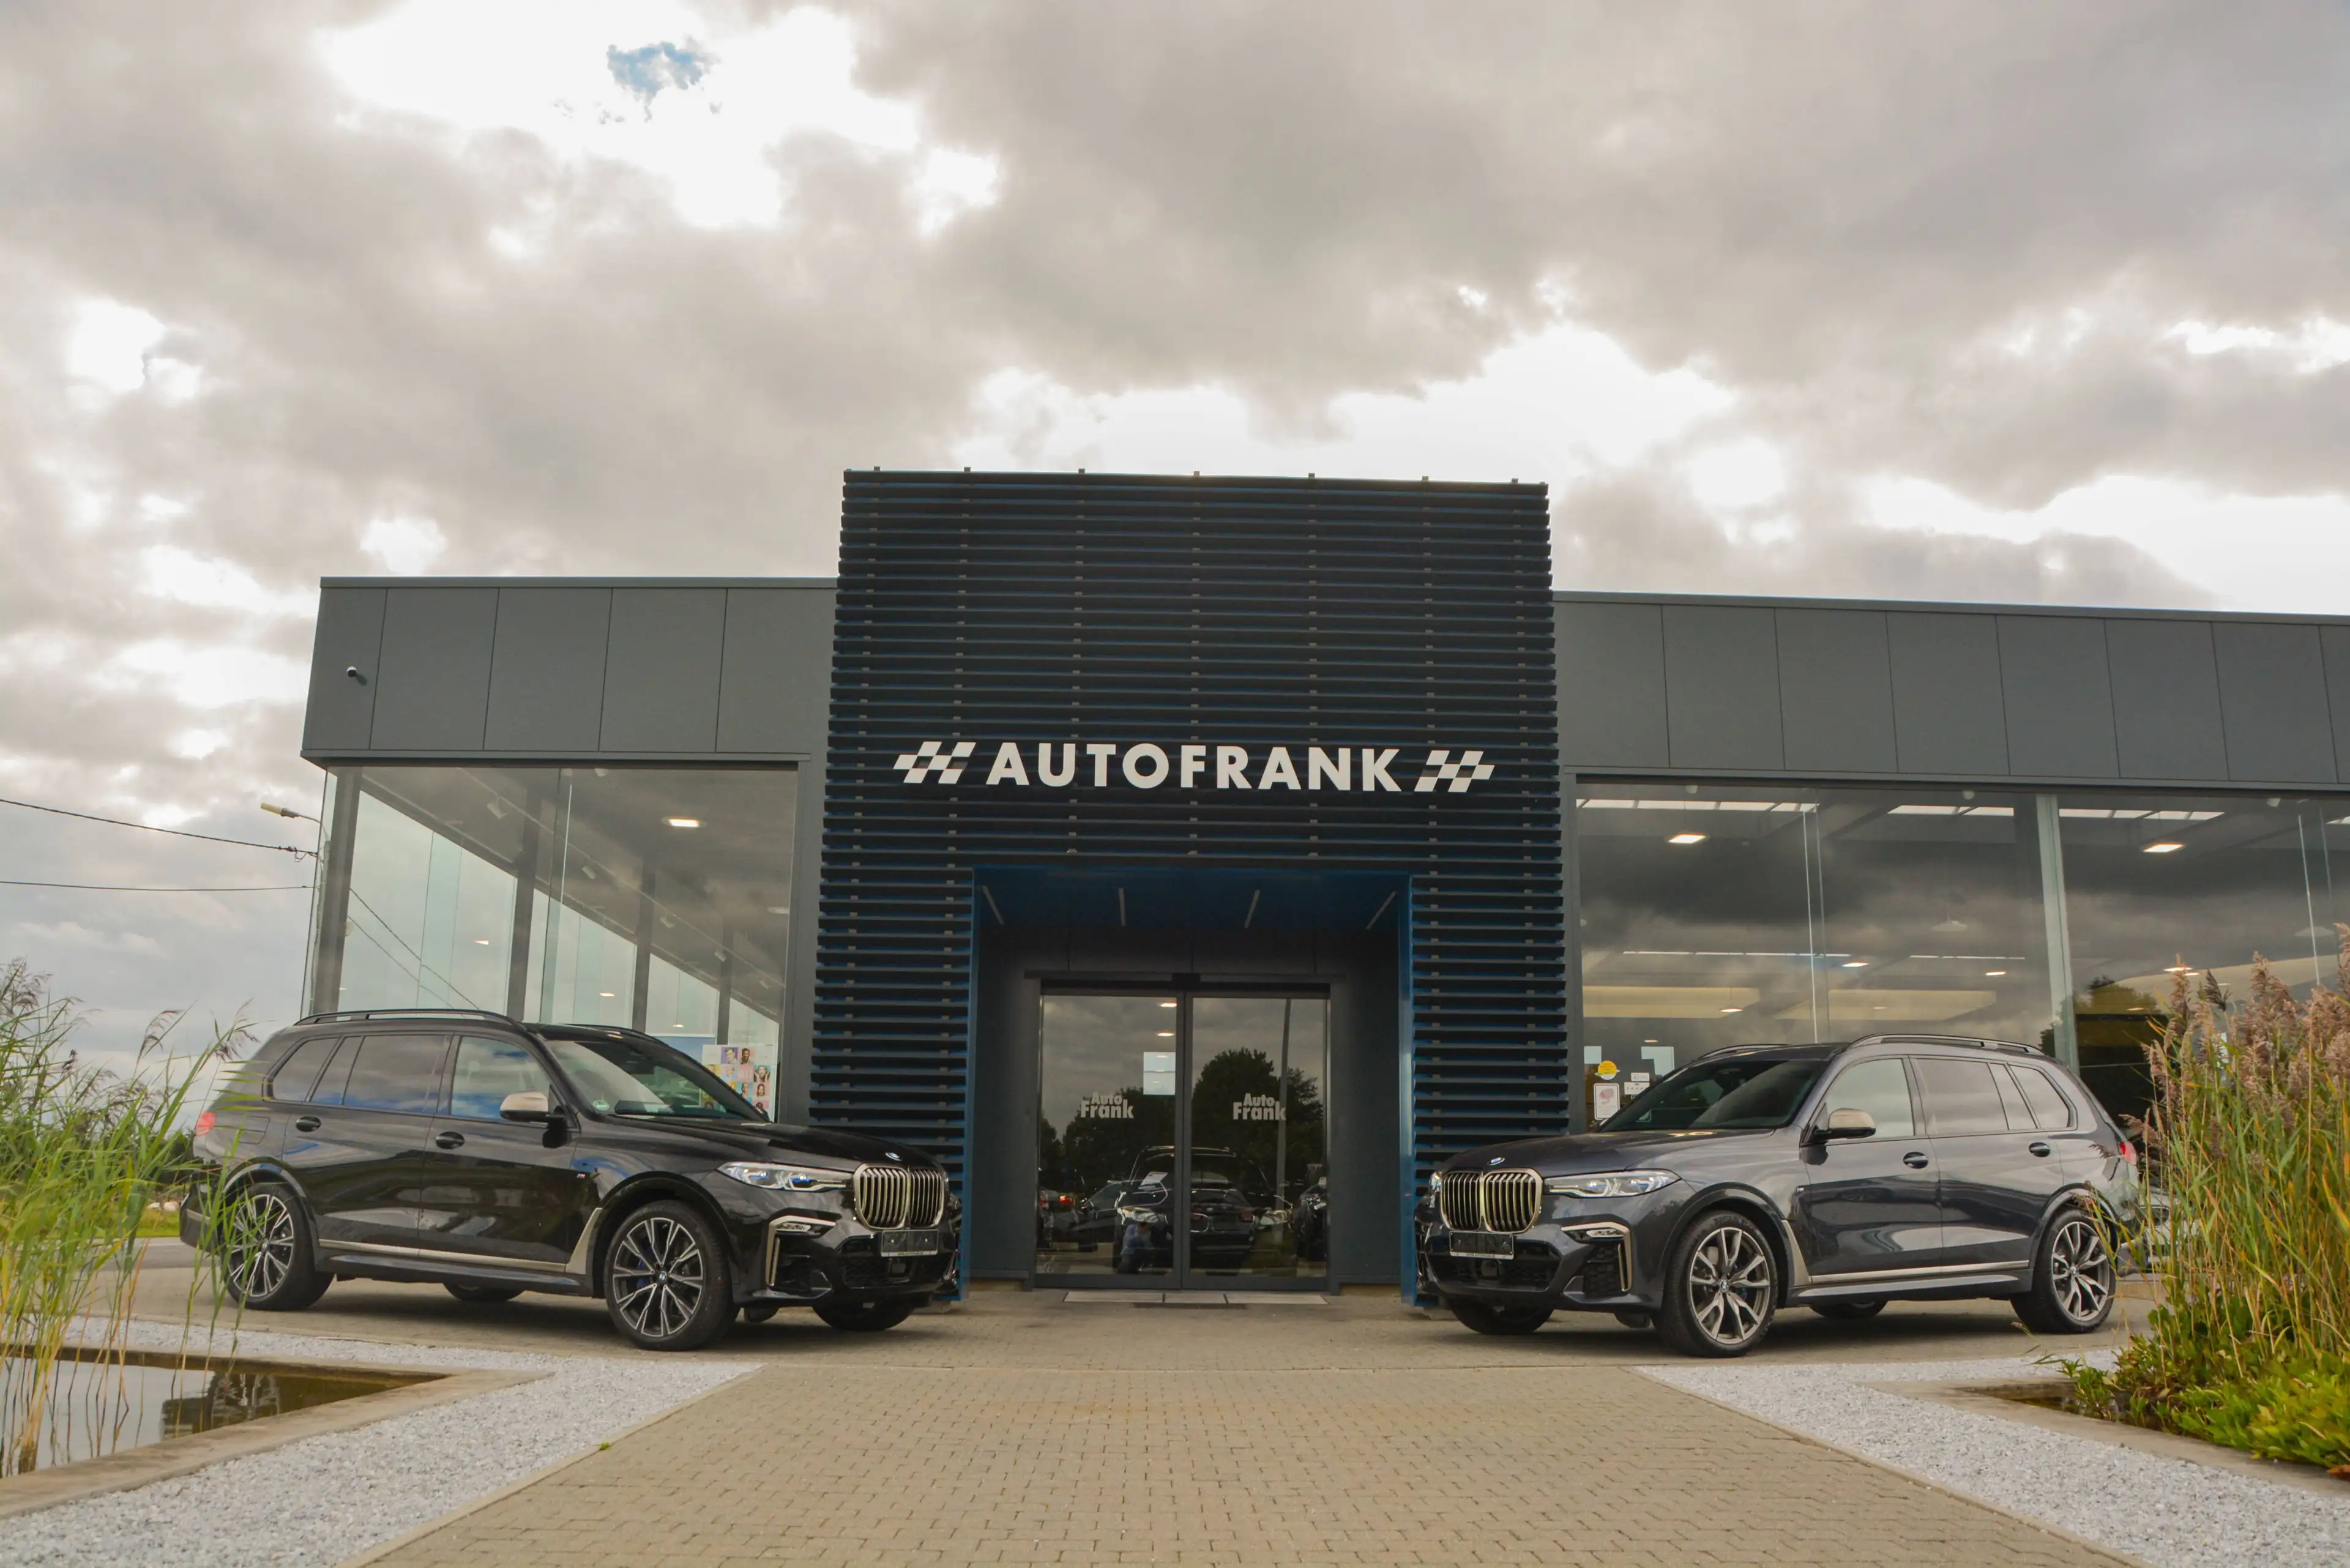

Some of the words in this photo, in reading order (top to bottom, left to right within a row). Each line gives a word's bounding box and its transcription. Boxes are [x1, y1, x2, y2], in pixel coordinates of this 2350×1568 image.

[986, 742, 1401, 792] AUTOFRANK
[1091, 1091, 1122, 1105] Auto
[1243, 1093, 1275, 1107] Auto
[1081, 1099, 1134, 1118] Frank
[1233, 1101, 1286, 1121] Frank
